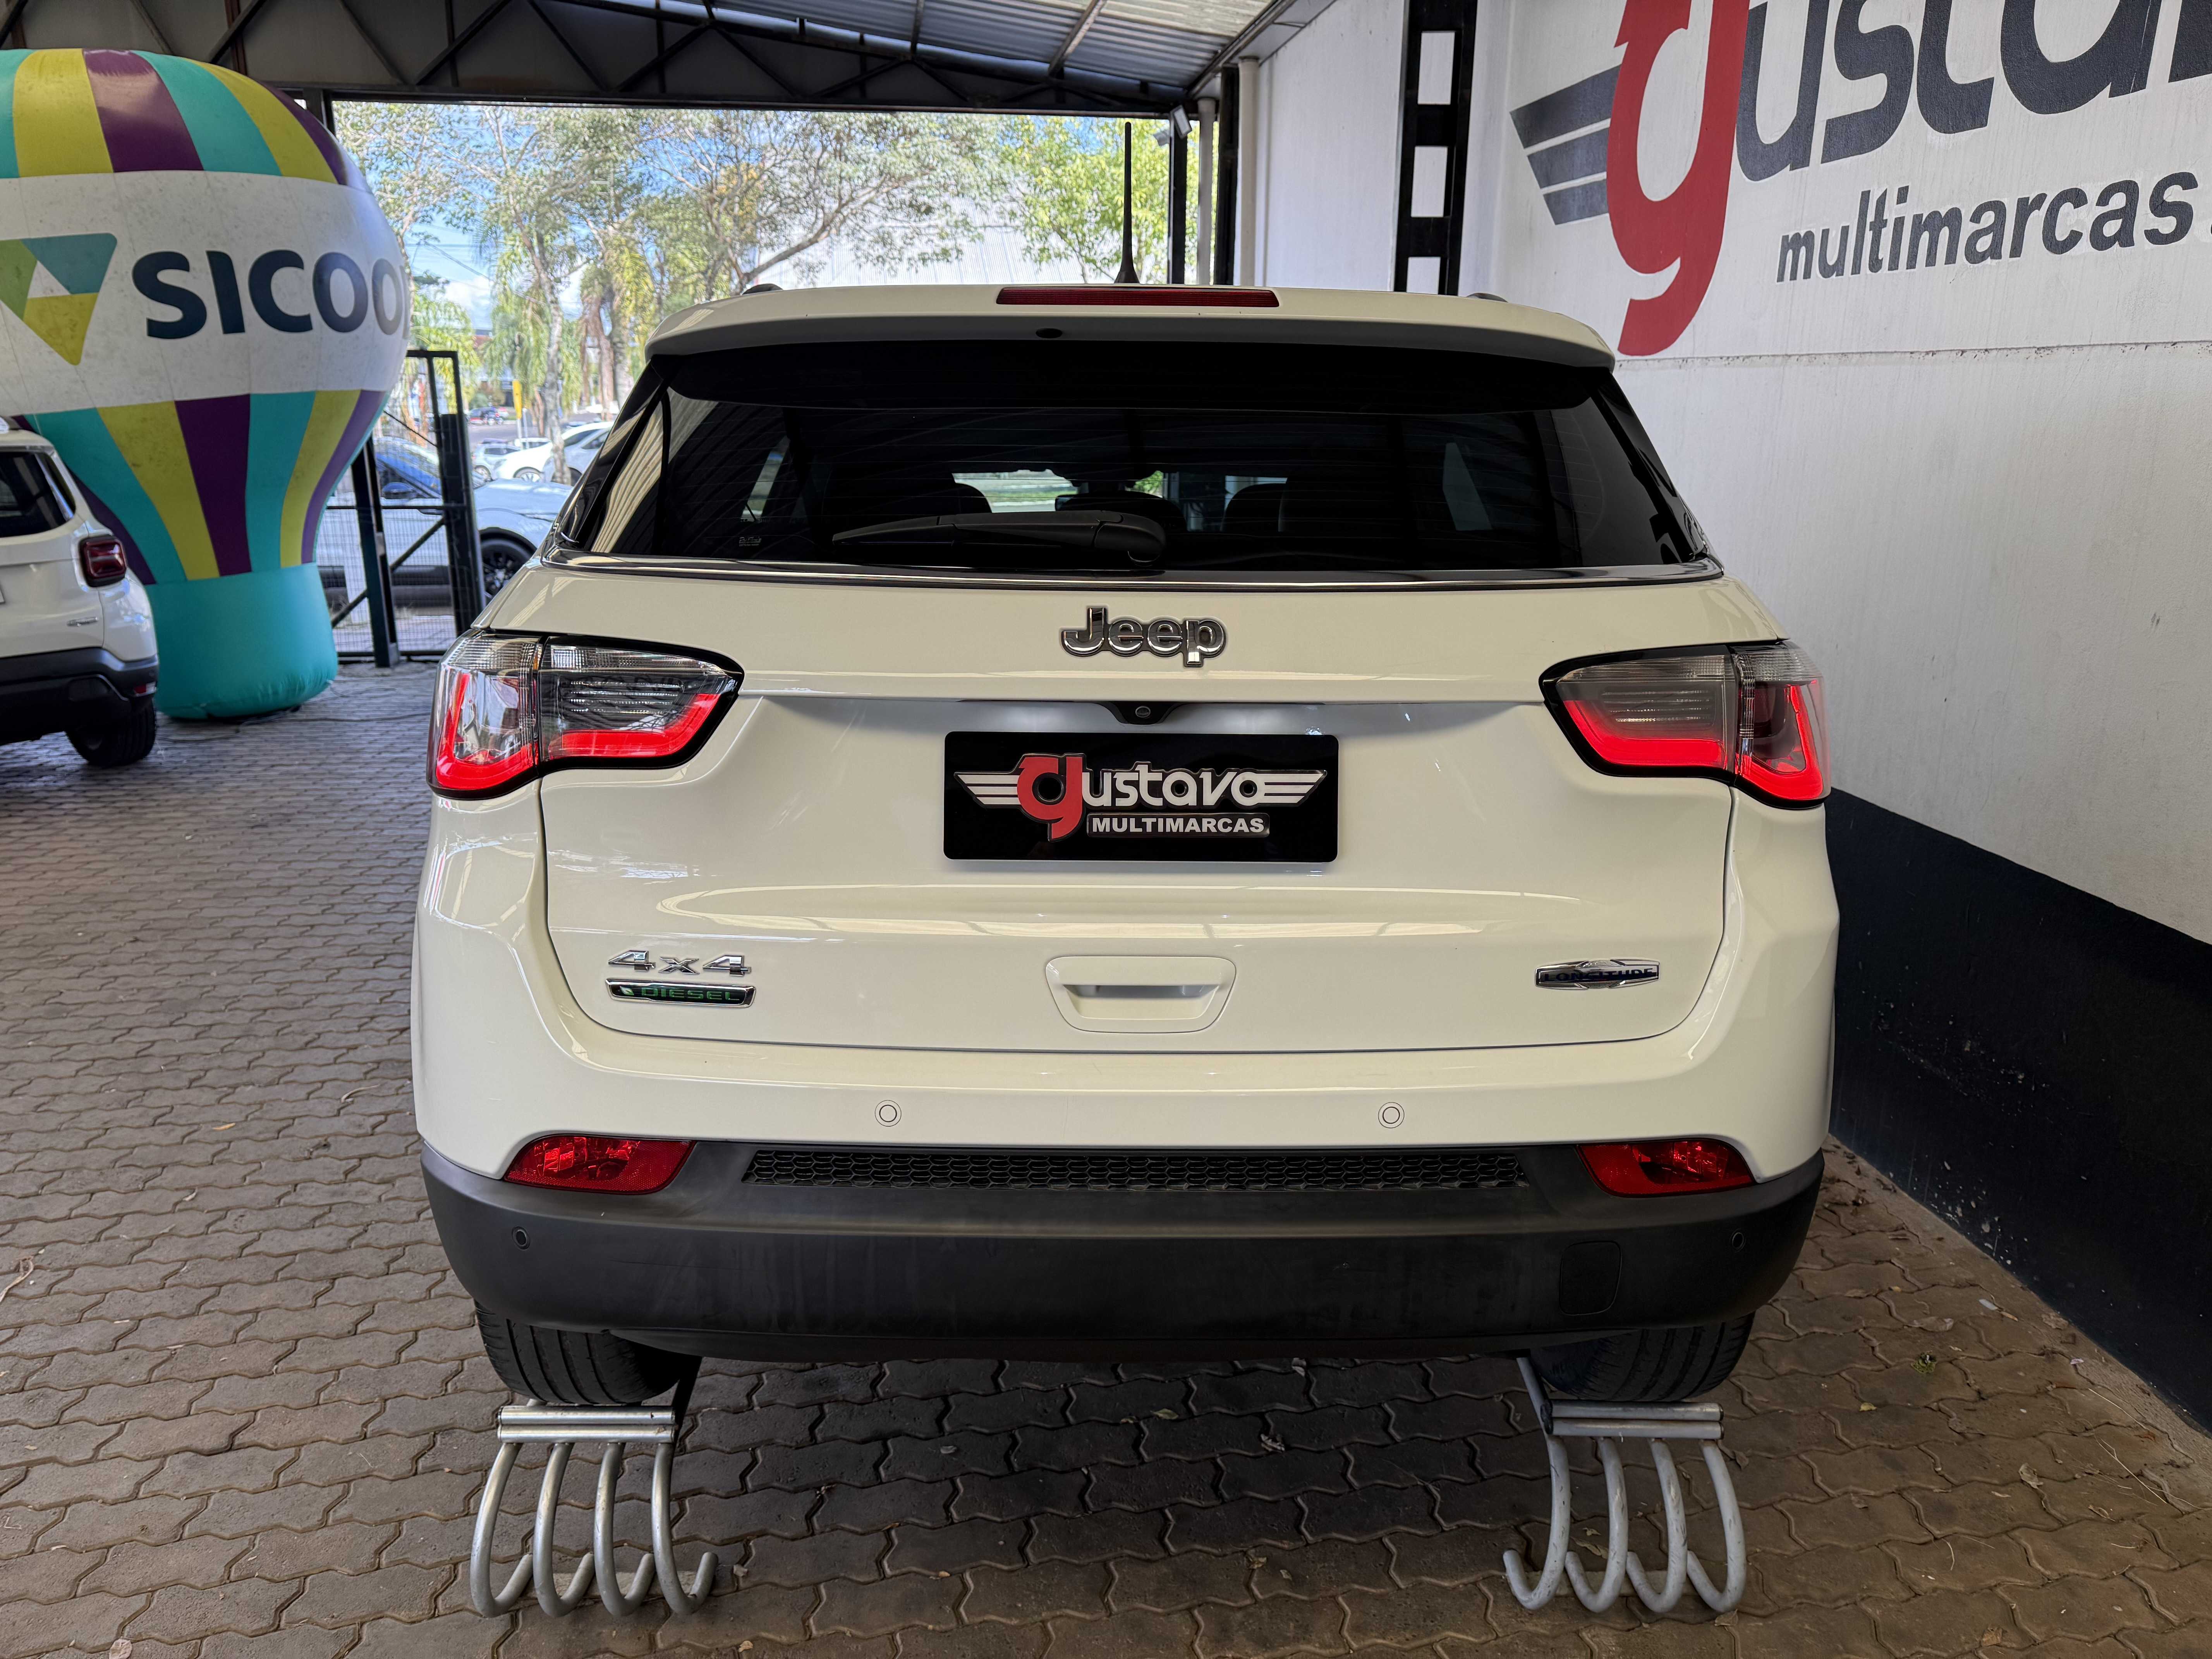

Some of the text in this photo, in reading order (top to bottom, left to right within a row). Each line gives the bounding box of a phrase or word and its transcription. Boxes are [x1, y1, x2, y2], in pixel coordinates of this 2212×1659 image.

[1606, 0, 2212, 356] gusta
[1776, 172, 2198, 283] multimarcas
[132, 249, 410, 339] SICOO
[1062, 606, 1226, 667] Jeep
[1017, 755, 1266, 840] gustavo
[1092, 817, 1264, 833] MULTIMARCAS
[641, 987, 740, 1001] DIESEL
[1544, 968, 1656, 982] LONGITUDE
